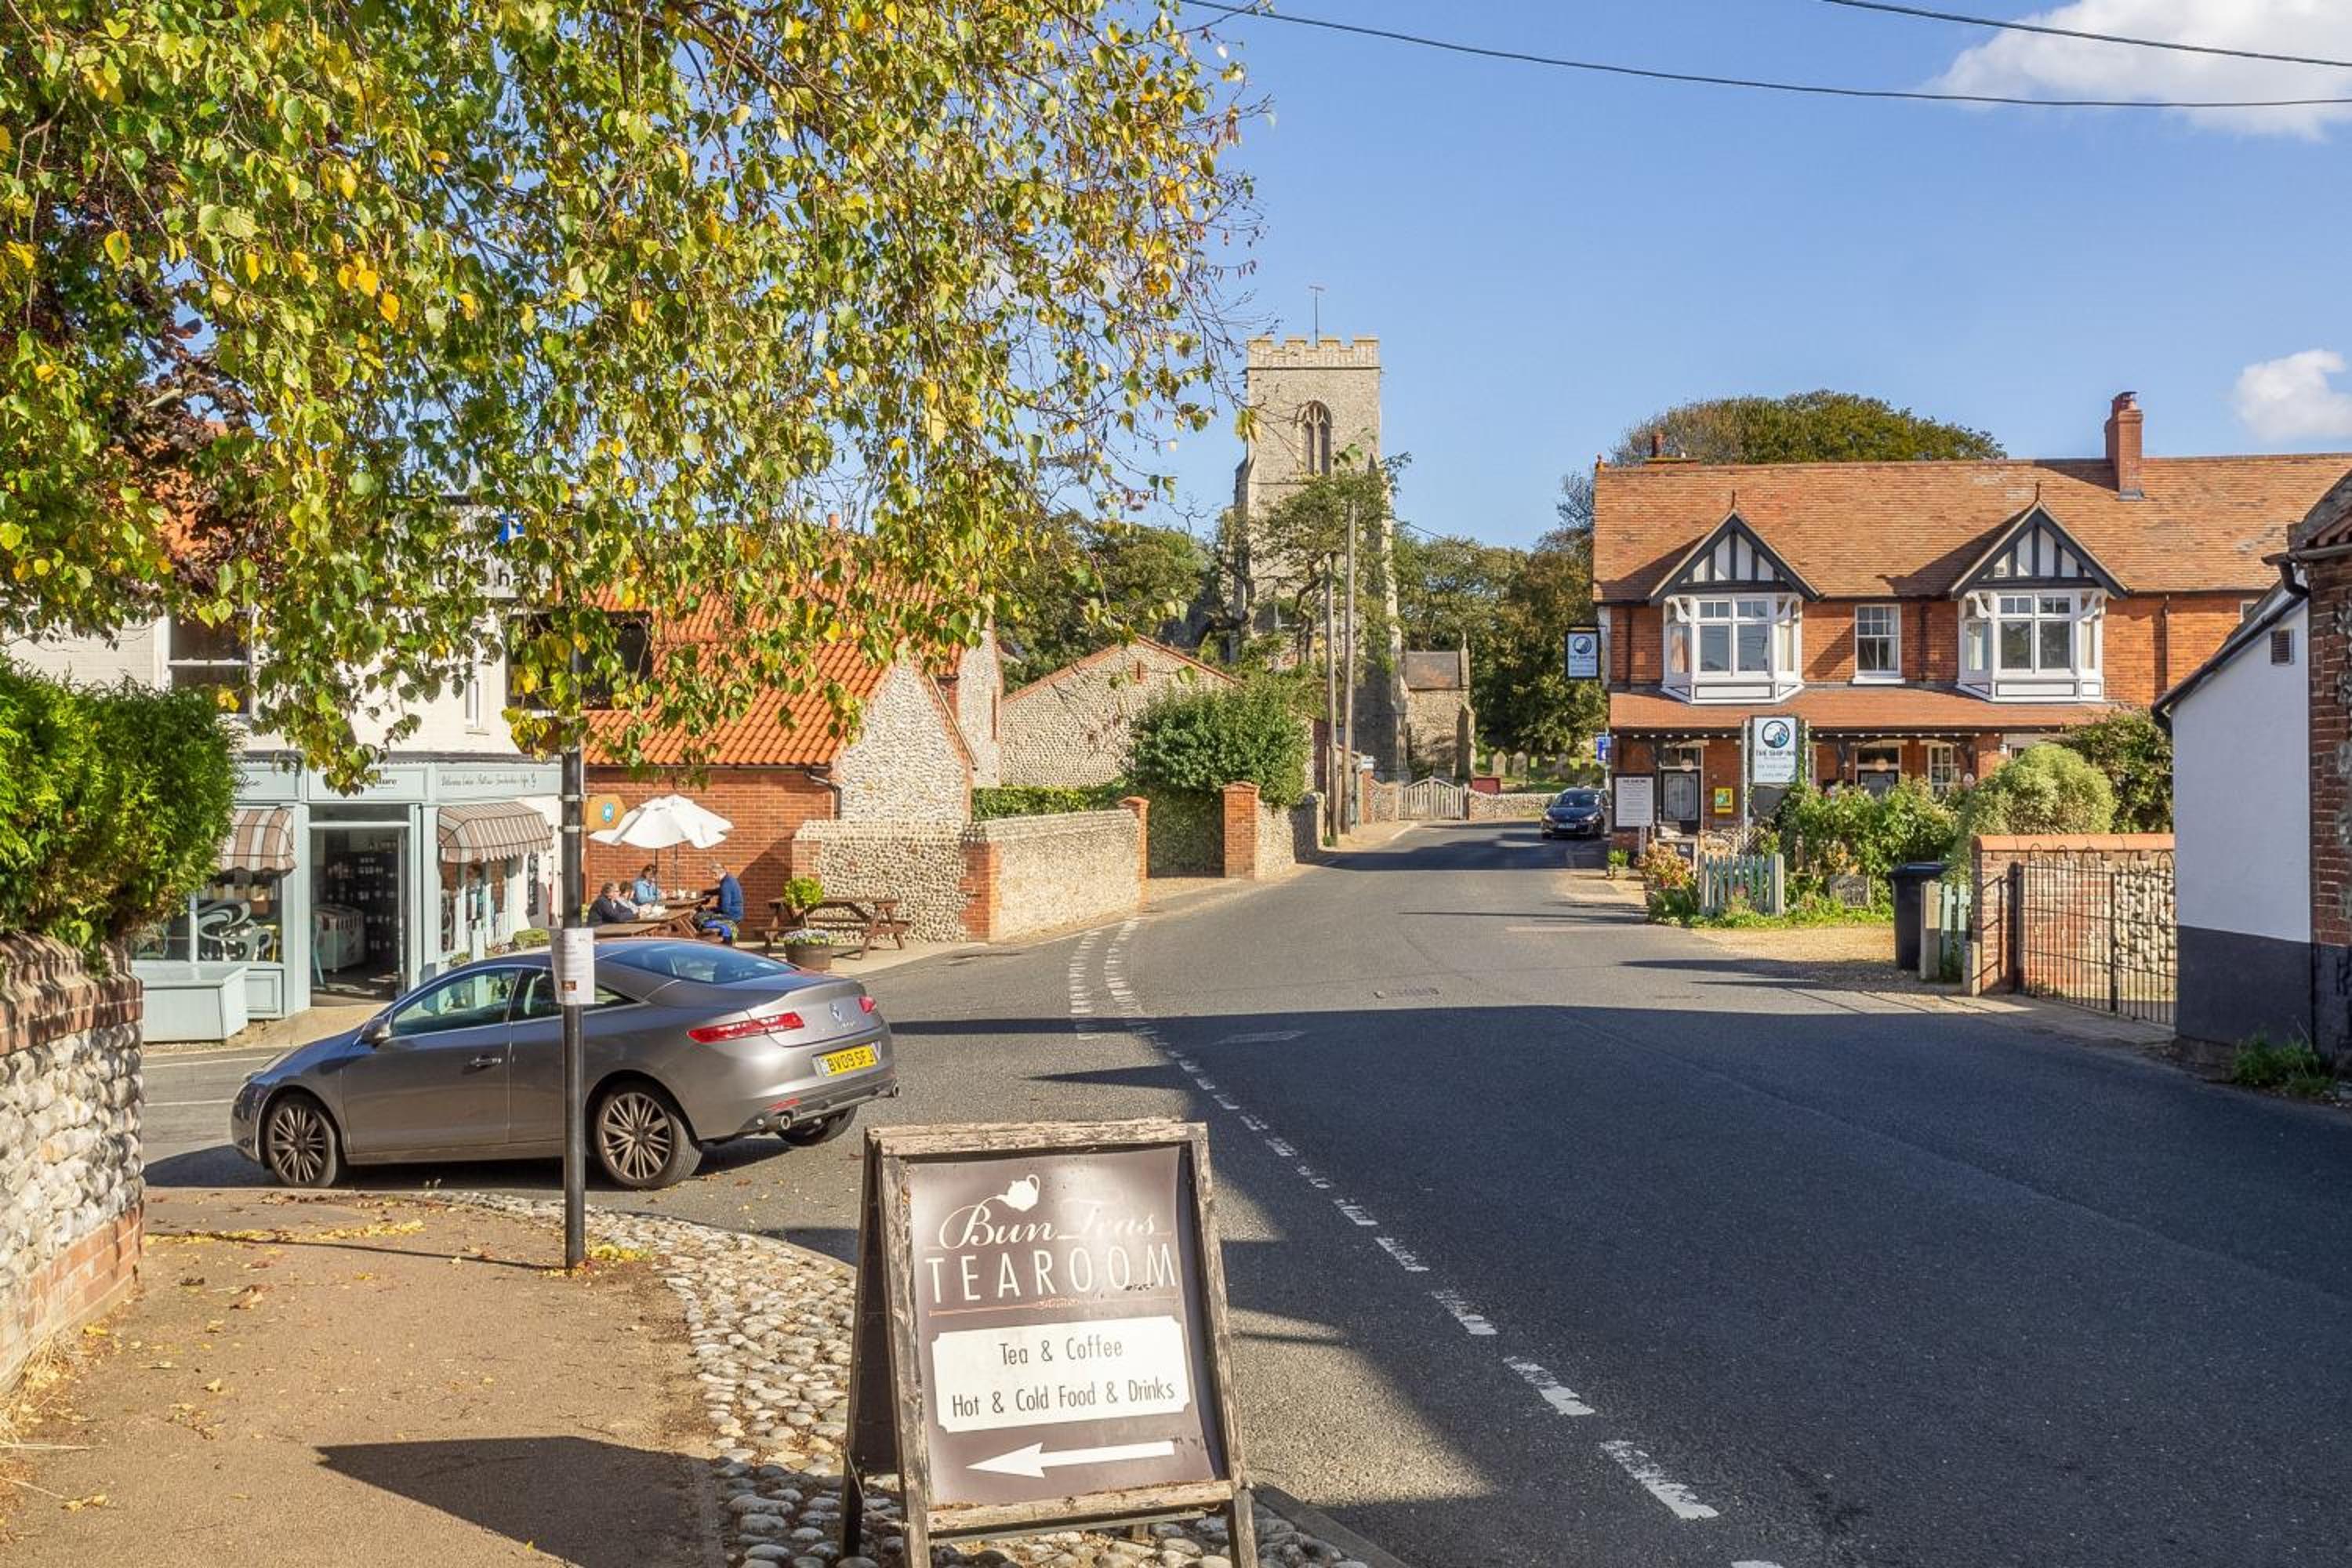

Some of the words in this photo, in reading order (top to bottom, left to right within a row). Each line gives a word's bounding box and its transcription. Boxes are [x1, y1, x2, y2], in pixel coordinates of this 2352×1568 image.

[826, 1053, 855, 1072] BV09
[939, 1204, 1058, 1249] Bun
[925, 1243, 1177, 1303] TEAROOM
[999, 1342, 1029, 1366] Tea
[1040, 1339, 1054, 1363] &
[1065, 1334, 1123, 1360] Coffee
[952, 1394, 979, 1417] Hot
[991, 1391, 1004, 1414] &
[1015, 1385, 1050, 1412] Cold
[1059, 1381, 1097, 1409] Food
[1106, 1381, 1119, 1404] &
[1127, 1376, 1176, 1403] Drinks
